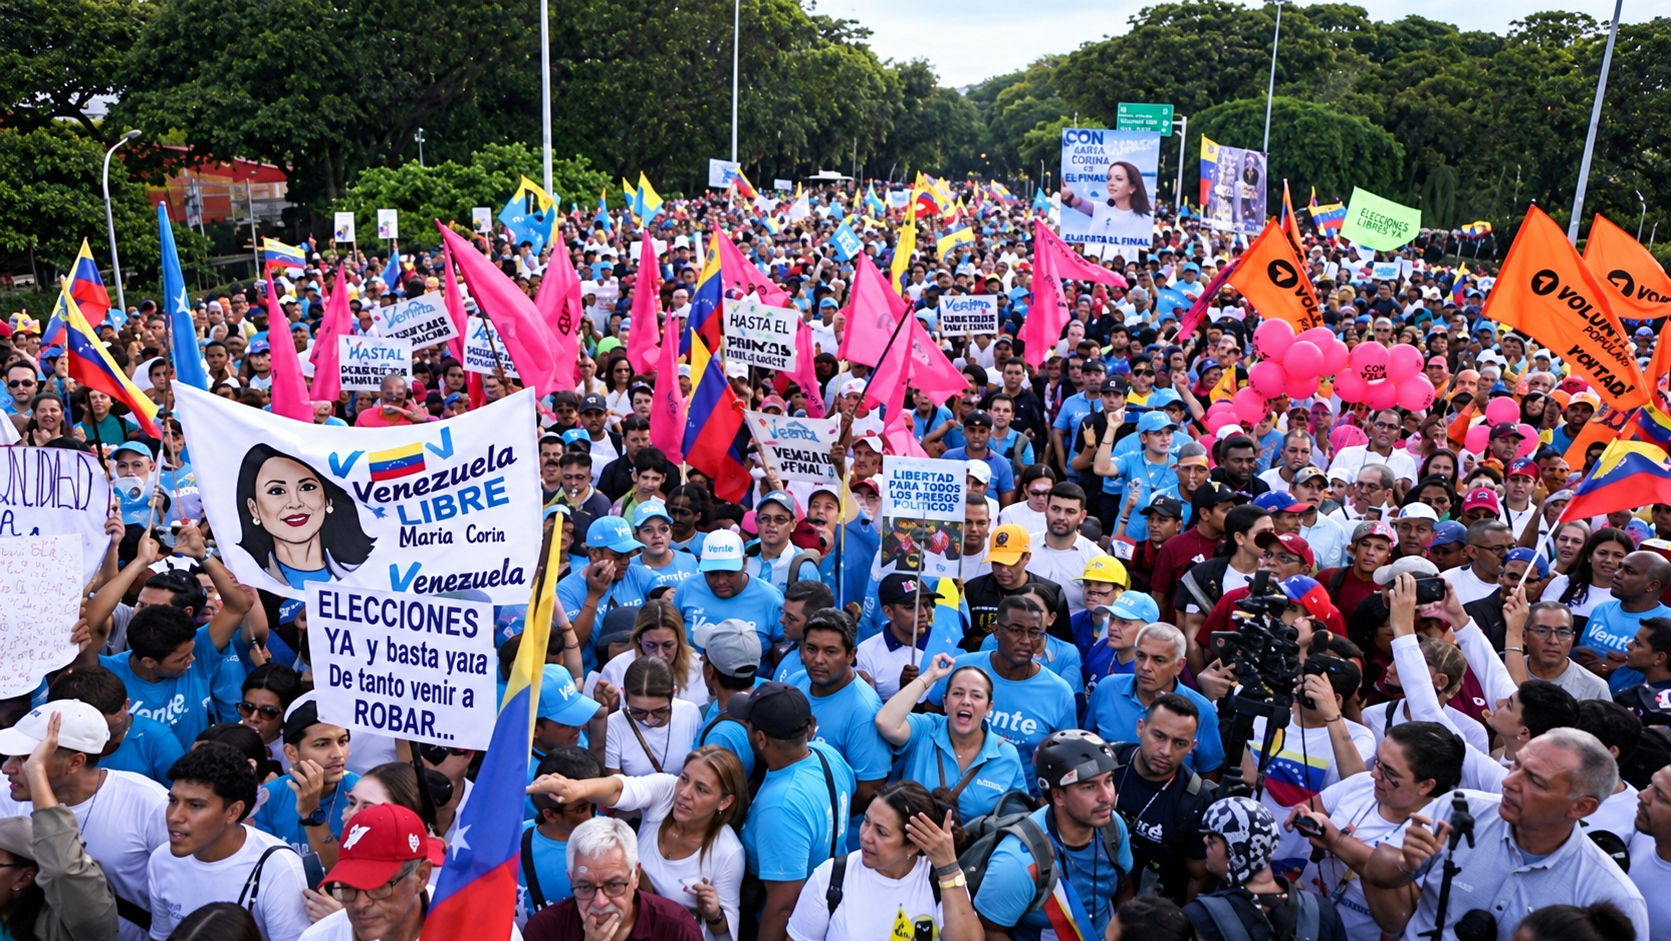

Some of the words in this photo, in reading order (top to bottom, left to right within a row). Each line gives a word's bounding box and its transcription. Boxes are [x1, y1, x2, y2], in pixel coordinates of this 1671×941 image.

[1065, 130, 1104, 145] CON
[1357, 217, 1388, 235] LIBRES
[1391, 229, 1402, 238] YA
[1360, 207, 1409, 233] ELECCIONES
[1121, 237, 1150, 247] FINAL
[729, 313, 771, 332] HASTA
[774, 319, 790, 334] EL
[1360, 371, 1387, 381] VZLA
[1364, 364, 1386, 373] CON
[352, 444, 518, 504] Venezuela
[893, 469, 954, 483] LIBERTAD
[889, 480, 919, 491] PARA
[923, 482, 961, 493] TODOS
[890, 490, 912, 500] LOS
[396, 476, 510, 525] LIBRE
[399, 525, 454, 548] Maria
[466, 524, 506, 544] Corin
[708, 544, 734, 553] Vente
[389, 557, 526, 595] Venezuela
[318, 590, 479, 638] ELECCIONES
[324, 626, 355, 657] YA
[366, 638, 379, 666] y
[386, 635, 439, 669] basta
[329, 663, 353, 690] De
[358, 667, 405, 698] tanto
[410, 679, 457, 706] venir
[462, 687, 474, 708] a
[354, 698, 455, 741] ROBAR...
